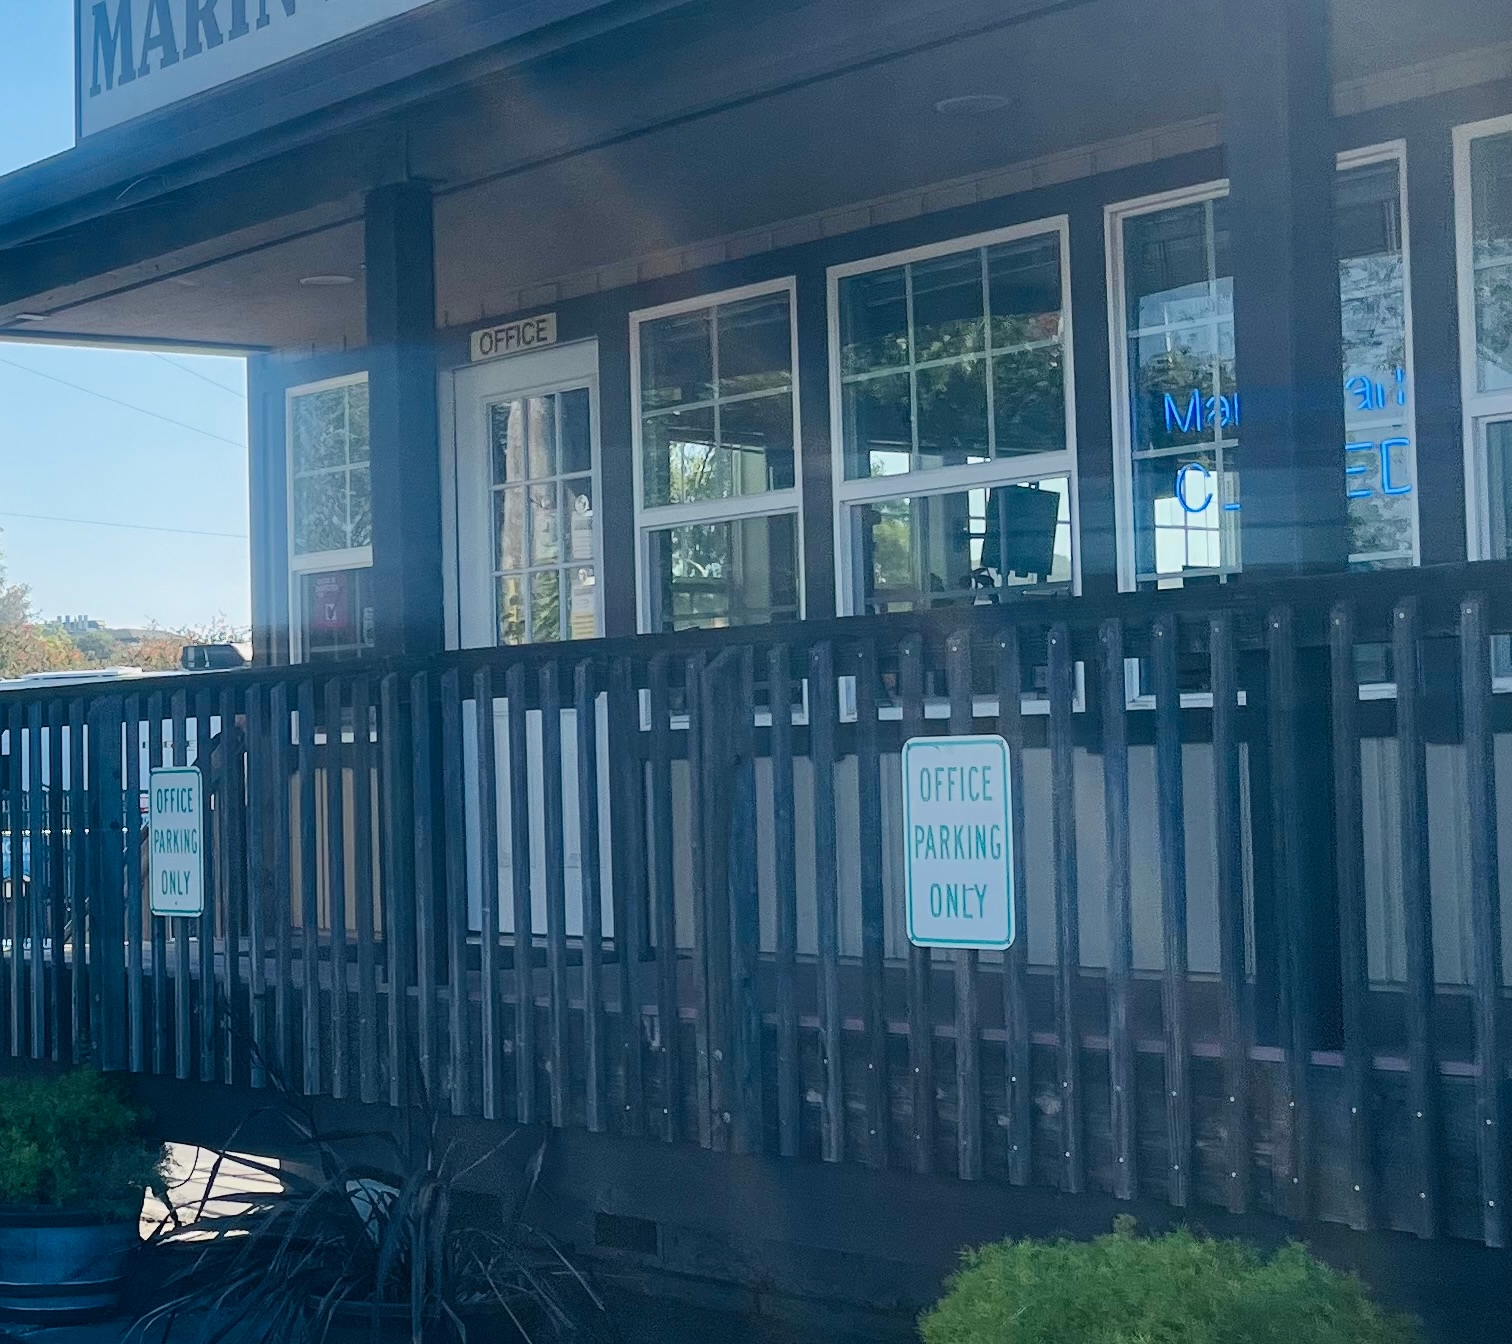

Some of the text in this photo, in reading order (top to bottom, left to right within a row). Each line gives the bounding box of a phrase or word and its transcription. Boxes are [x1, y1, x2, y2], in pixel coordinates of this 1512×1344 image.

[479, 317, 548, 355] OFFICE
[156, 787, 194, 814] OFFICE
[919, 765, 993, 802] OFFICE
[154, 828, 198, 855] PARKING
[914, 824, 1002, 861] PARKING
[161, 869, 191, 896] ONLY
[930, 883, 988, 919] ONLY
